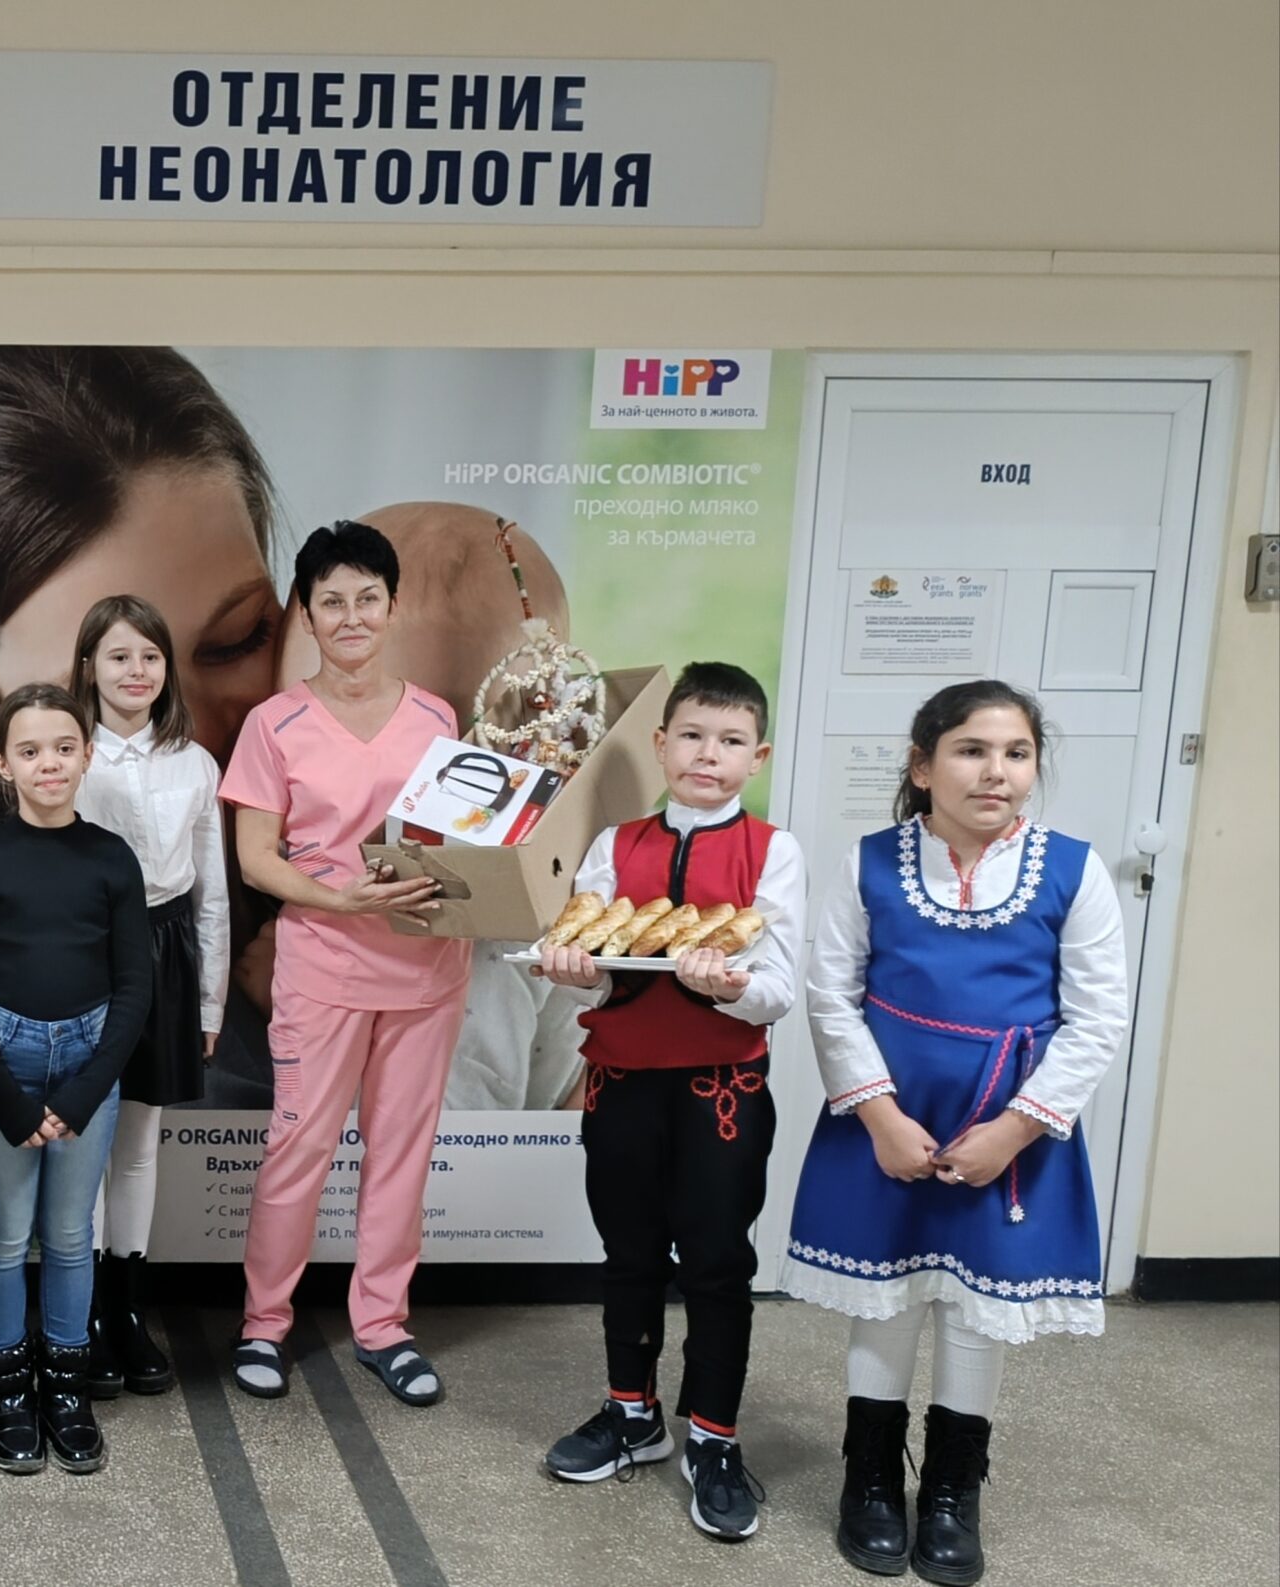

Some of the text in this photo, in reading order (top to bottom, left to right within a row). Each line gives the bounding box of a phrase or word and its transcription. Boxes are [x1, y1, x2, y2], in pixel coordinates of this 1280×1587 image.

[171, 69, 587, 135] ОТДЕЛЕНИЕ
[99, 145, 653, 208] НЕОНАТОЛОГИЯ
[622, 358, 741, 396] HiPP
[601, 405, 758, 419] За най-ценното в живота.
[444, 463, 499, 485] HiPP
[503, 463, 612, 485] ORGANIC
[980, 463, 1031, 485] ВХОД
[574, 500, 759, 520] преходно мляко
[607, 529, 756, 550] за кърмачета
[433, 1134, 508, 1149] реходно
[513, 1134, 571, 1146] мляко
[433, 1230, 491, 1240] имунната
[494, 1230, 543, 1239] система
